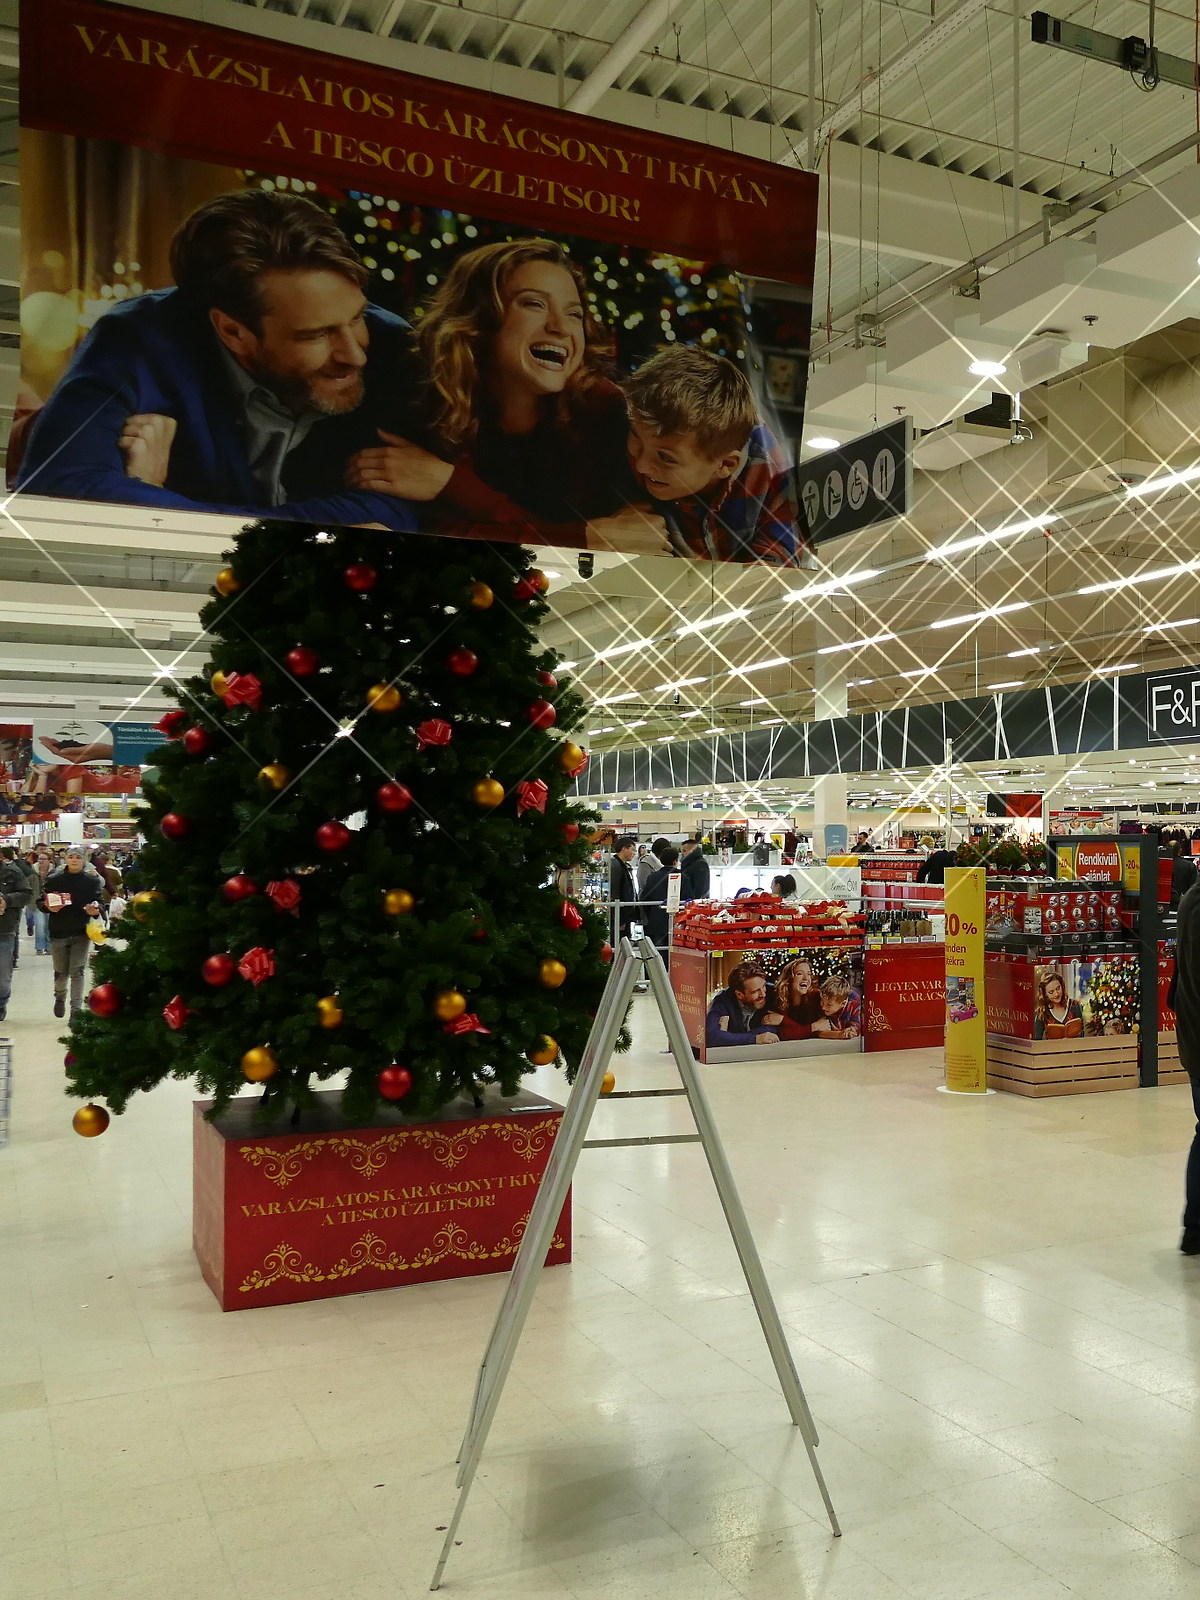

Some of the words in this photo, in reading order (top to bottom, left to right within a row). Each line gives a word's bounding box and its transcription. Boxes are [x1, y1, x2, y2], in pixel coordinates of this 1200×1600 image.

[73, 23, 395, 119] VARÁZSLATOS
[403, 98, 661, 180] KARÁCSONYT
[669, 160, 772, 208] KÍVÁN
[264, 121, 296, 149] A
[304, 127, 435, 178] TESCO
[443, 155, 641, 222] ÜZLETSOR!
[1078, 852, 1118, 866] Rendkívüli
[875, 981, 919, 992] LEGYEN
[899, 990, 946, 1002] KARÁCSO
[240, 1190, 380, 1218] VARÁZSLATOS
[383, 1176, 507, 1202] KARÁCSONYT
[509, 1171, 542, 1188] KÍV
[320, 1213, 335, 1227] A
[338, 1206, 398, 1224] TESCO
[401, 1194, 496, 1217] ÜZLETSOR!
